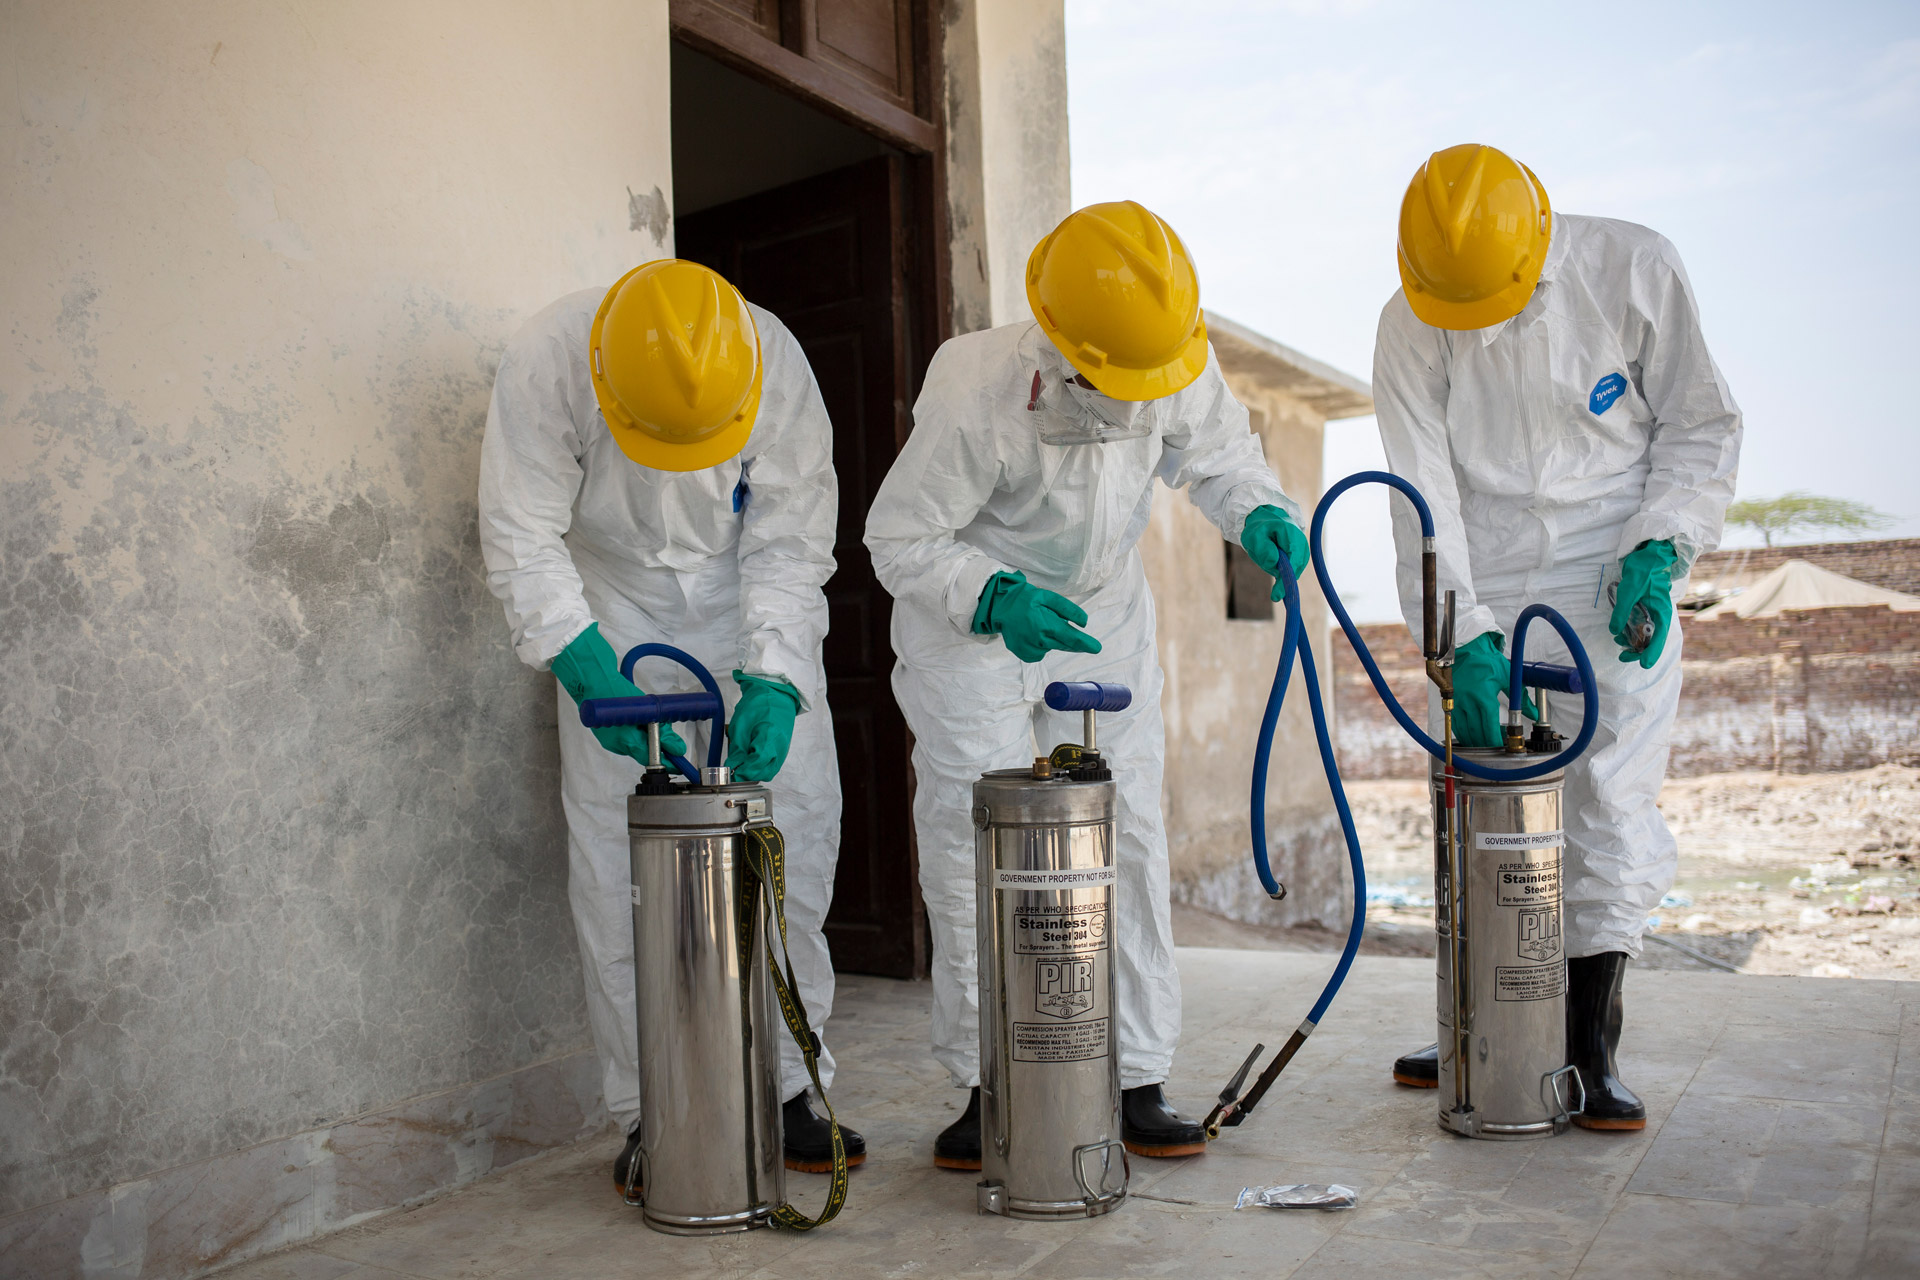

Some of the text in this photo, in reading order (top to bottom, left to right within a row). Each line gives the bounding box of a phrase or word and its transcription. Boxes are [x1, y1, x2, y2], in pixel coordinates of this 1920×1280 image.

[1595, 384, 1618, 401] Tyvek
[1485, 837, 1530, 845] GOVERNMENT
[1531, 836, 1557, 844] PROPERTY
[1000, 874, 1046, 883] GOVERNMENT
[1049, 874, 1085, 883] PROPERTY
[1086, 872, 1098, 881] NOT
[1098, 871, 1107, 880] FOR
[1503, 873, 1557, 884] Stainless
[1524, 883, 1557, 894] Steel 304
[1025, 906, 1040, 914] PER
[1043, 905, 1061, 914] WHO
[1019, 918, 1087, 929] Stainless
[1521, 910, 1559, 940] PIR
[1042, 930, 1087, 942] Steel 304
[1029, 943, 1055, 951] Sprayers
[1073, 941, 1088, 949] metal
[1088, 940, 1106, 948] supreme
[1039, 961, 1092, 994] PIR
[1055, 1024, 1076, 1032] SPRAYER
